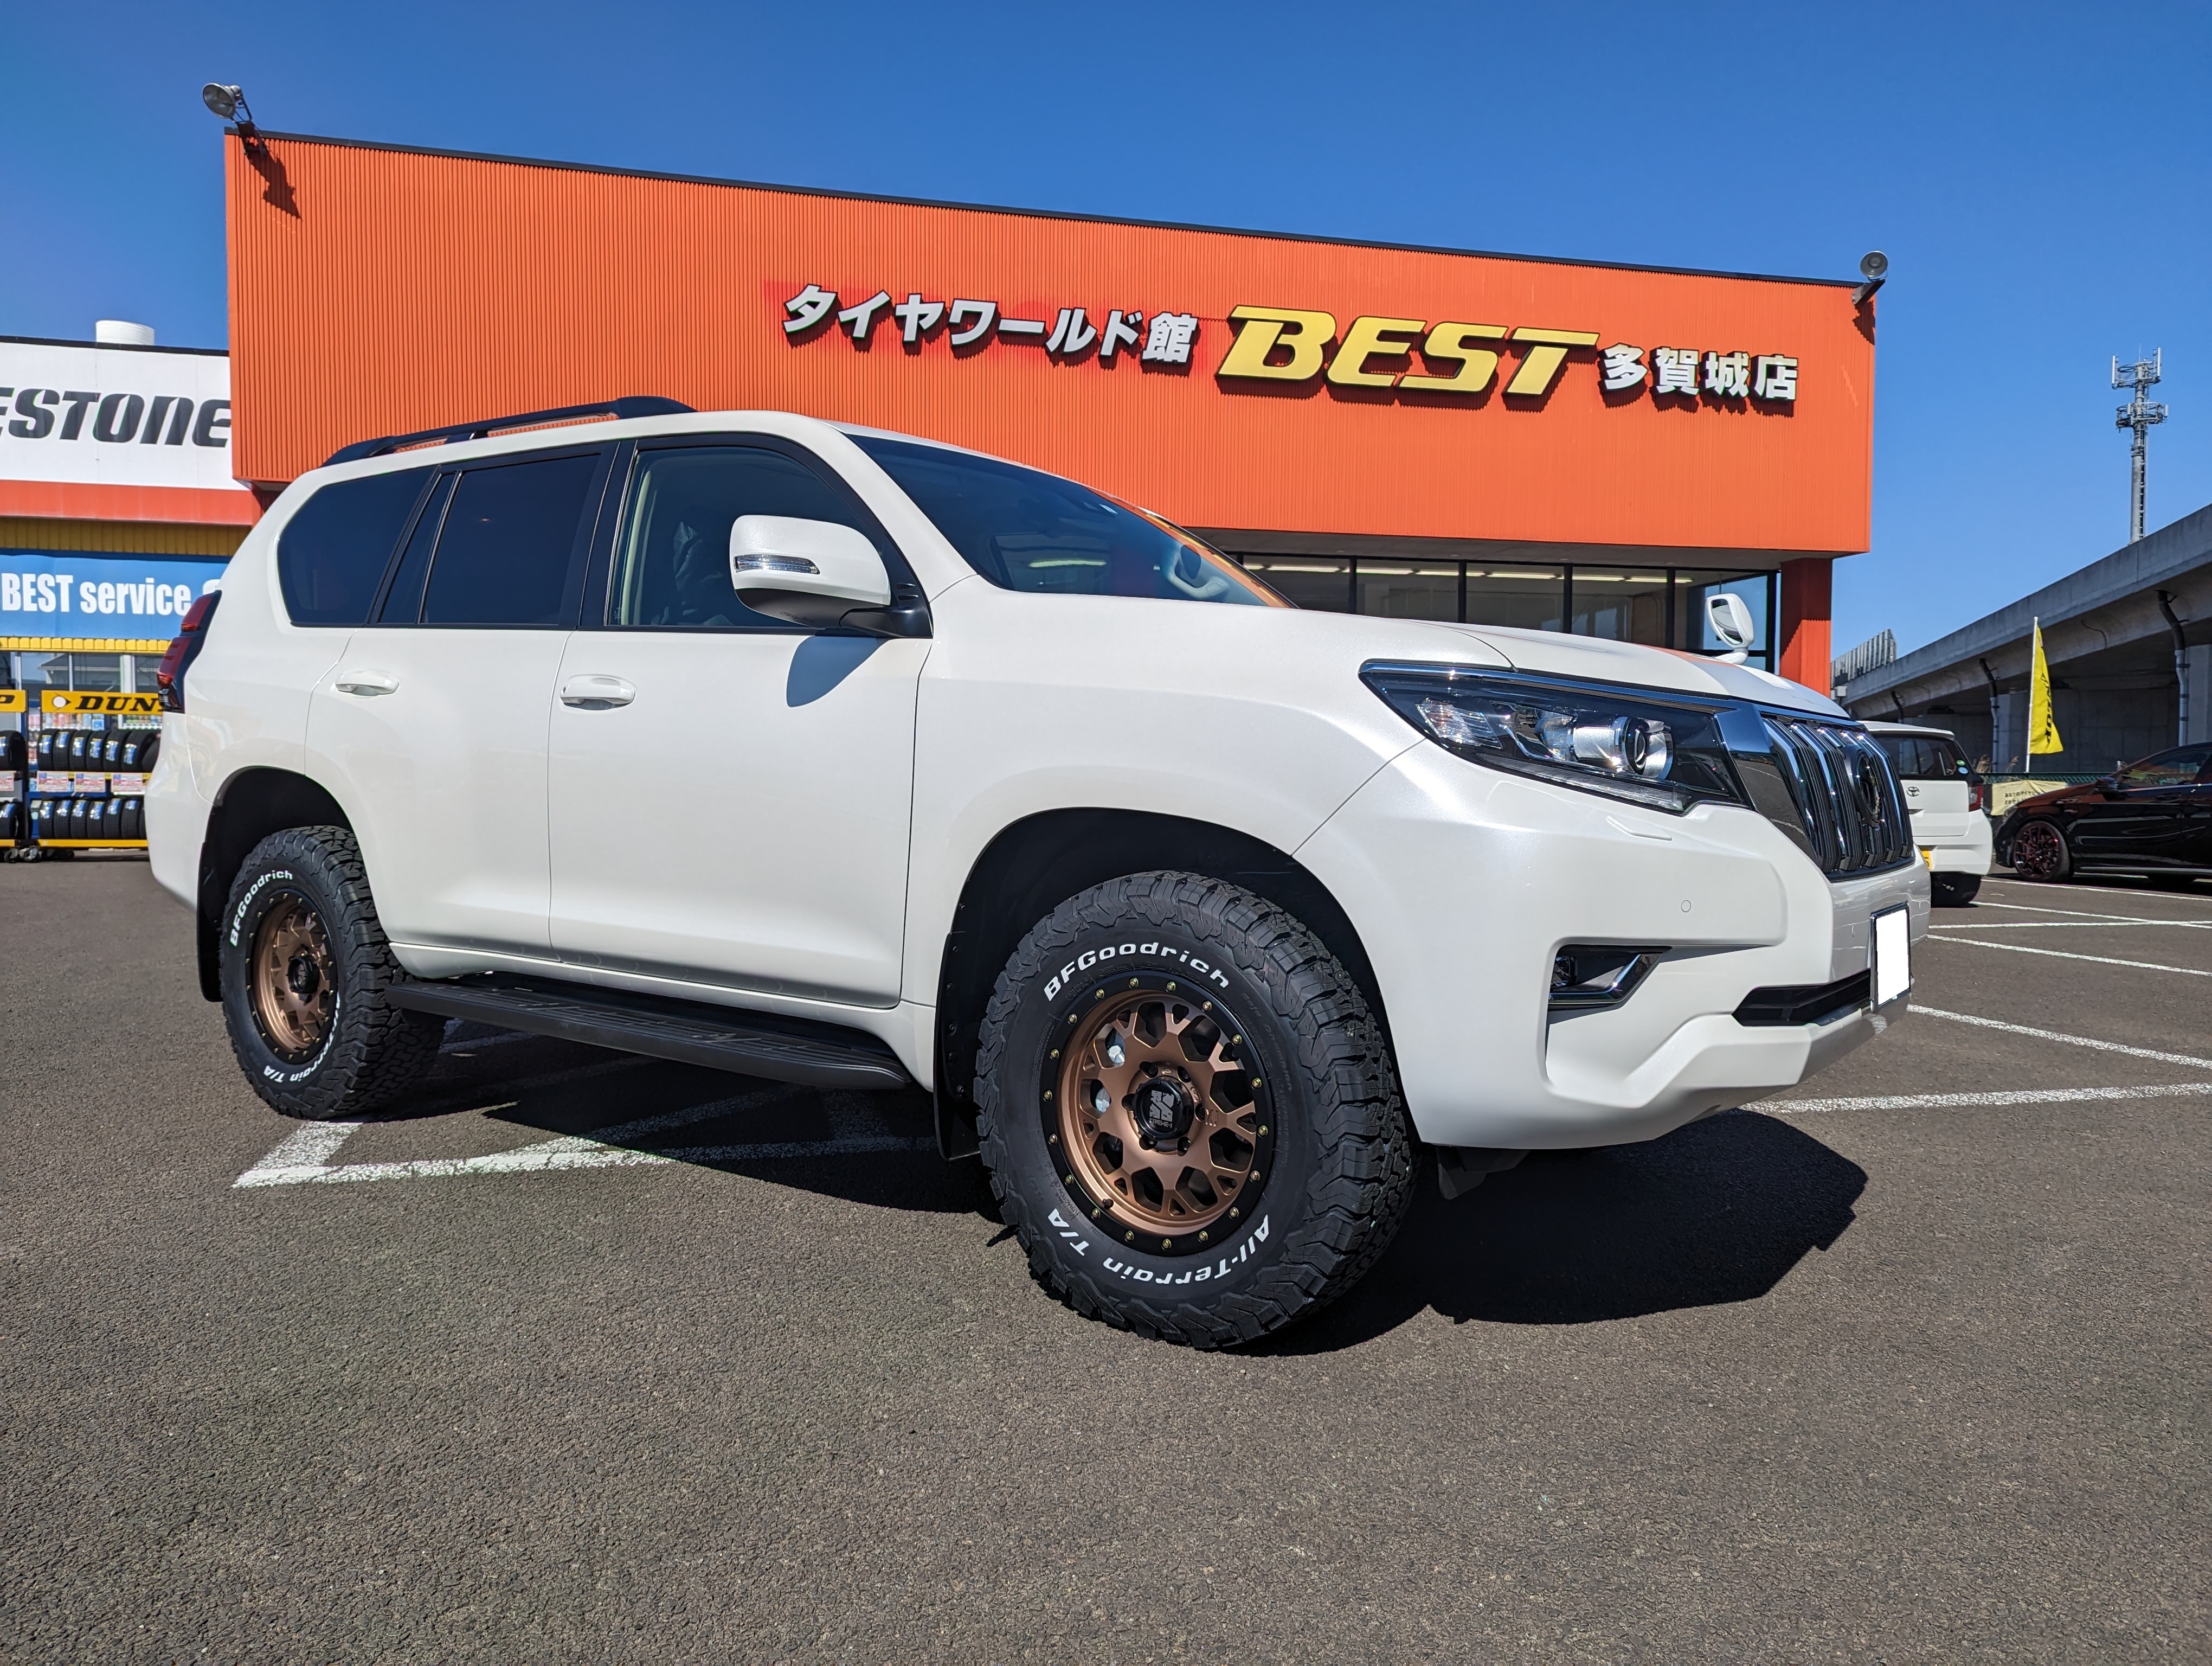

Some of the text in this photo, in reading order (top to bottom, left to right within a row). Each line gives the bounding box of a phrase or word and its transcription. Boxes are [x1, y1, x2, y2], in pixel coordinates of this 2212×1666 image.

[782, 283, 1799, 402] タイヤワールド館 BEST 多賀城店
[0, 387, 232, 448] STONE
[2, 573, 74, 613] BEST
[80, 578, 191, 616] service
[75, 695, 163, 712] DUN
[230, 869, 293, 948] BFGoodrich
[1043, 941, 1231, 1002] BFGoodrich
[263, 1065, 286, 1084] T/A
[1058, 1188, 1077, 1213] TRACTION
[1046, 1207, 1270, 1289] All-Terrain T/A
